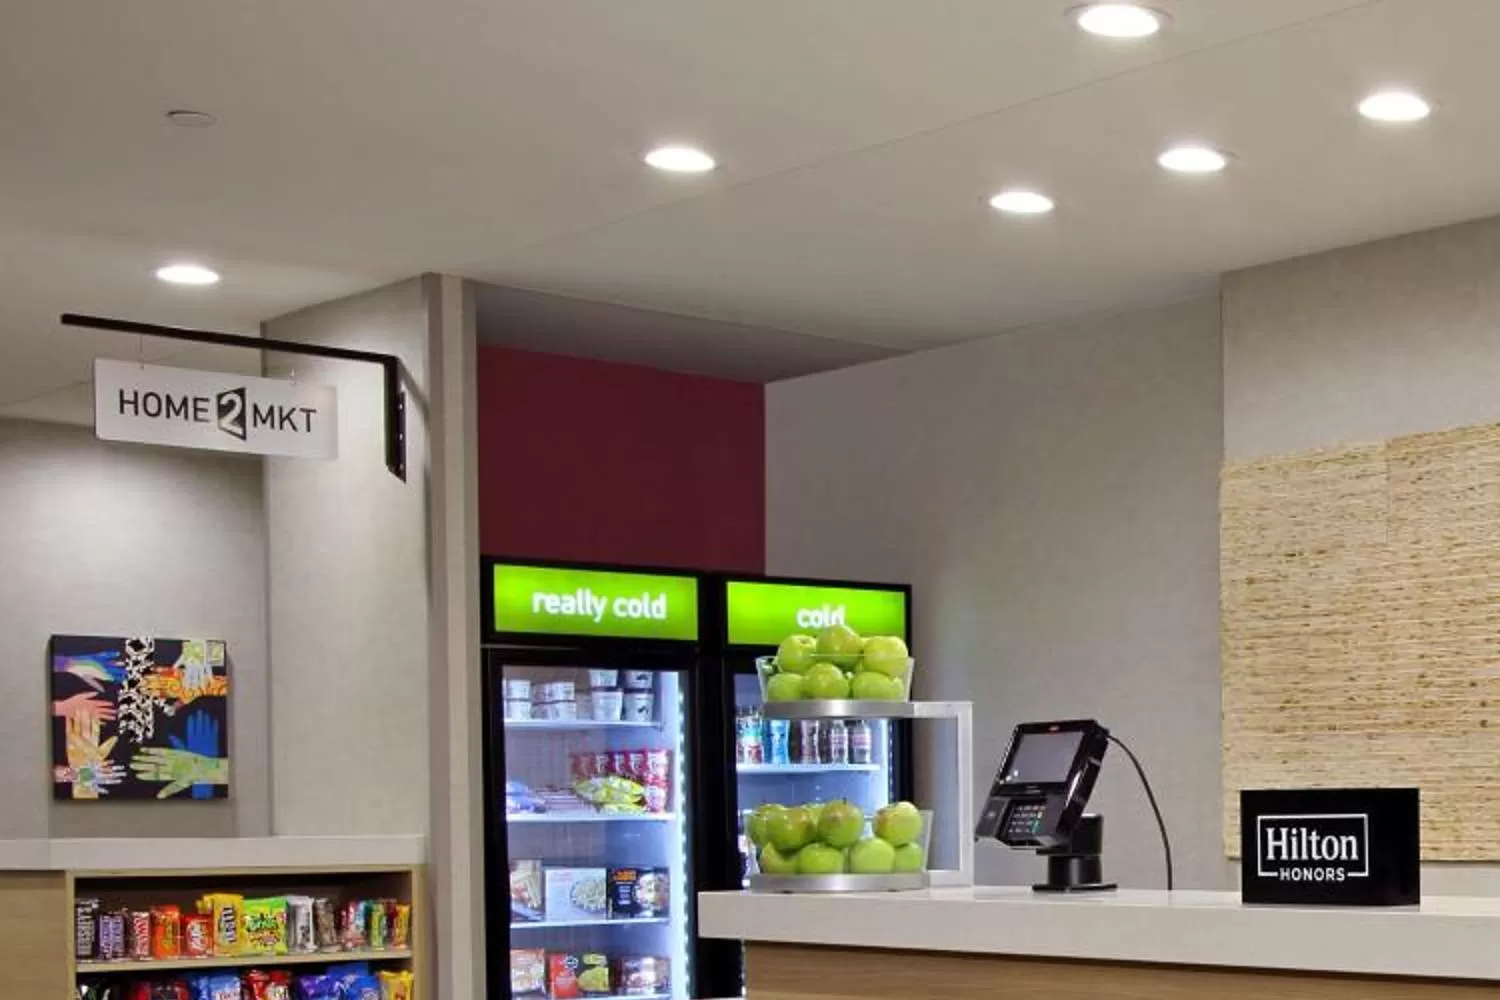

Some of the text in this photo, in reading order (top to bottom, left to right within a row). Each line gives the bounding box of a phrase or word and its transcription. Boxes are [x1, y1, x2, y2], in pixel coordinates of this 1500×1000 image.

[118, 388, 210, 423] HOME
[252, 403, 317, 433] MKT
[532, 588, 667, 623] really cold
[1265, 827, 1359, 861] Hilton
[1279, 867, 1346, 882] HONORS
